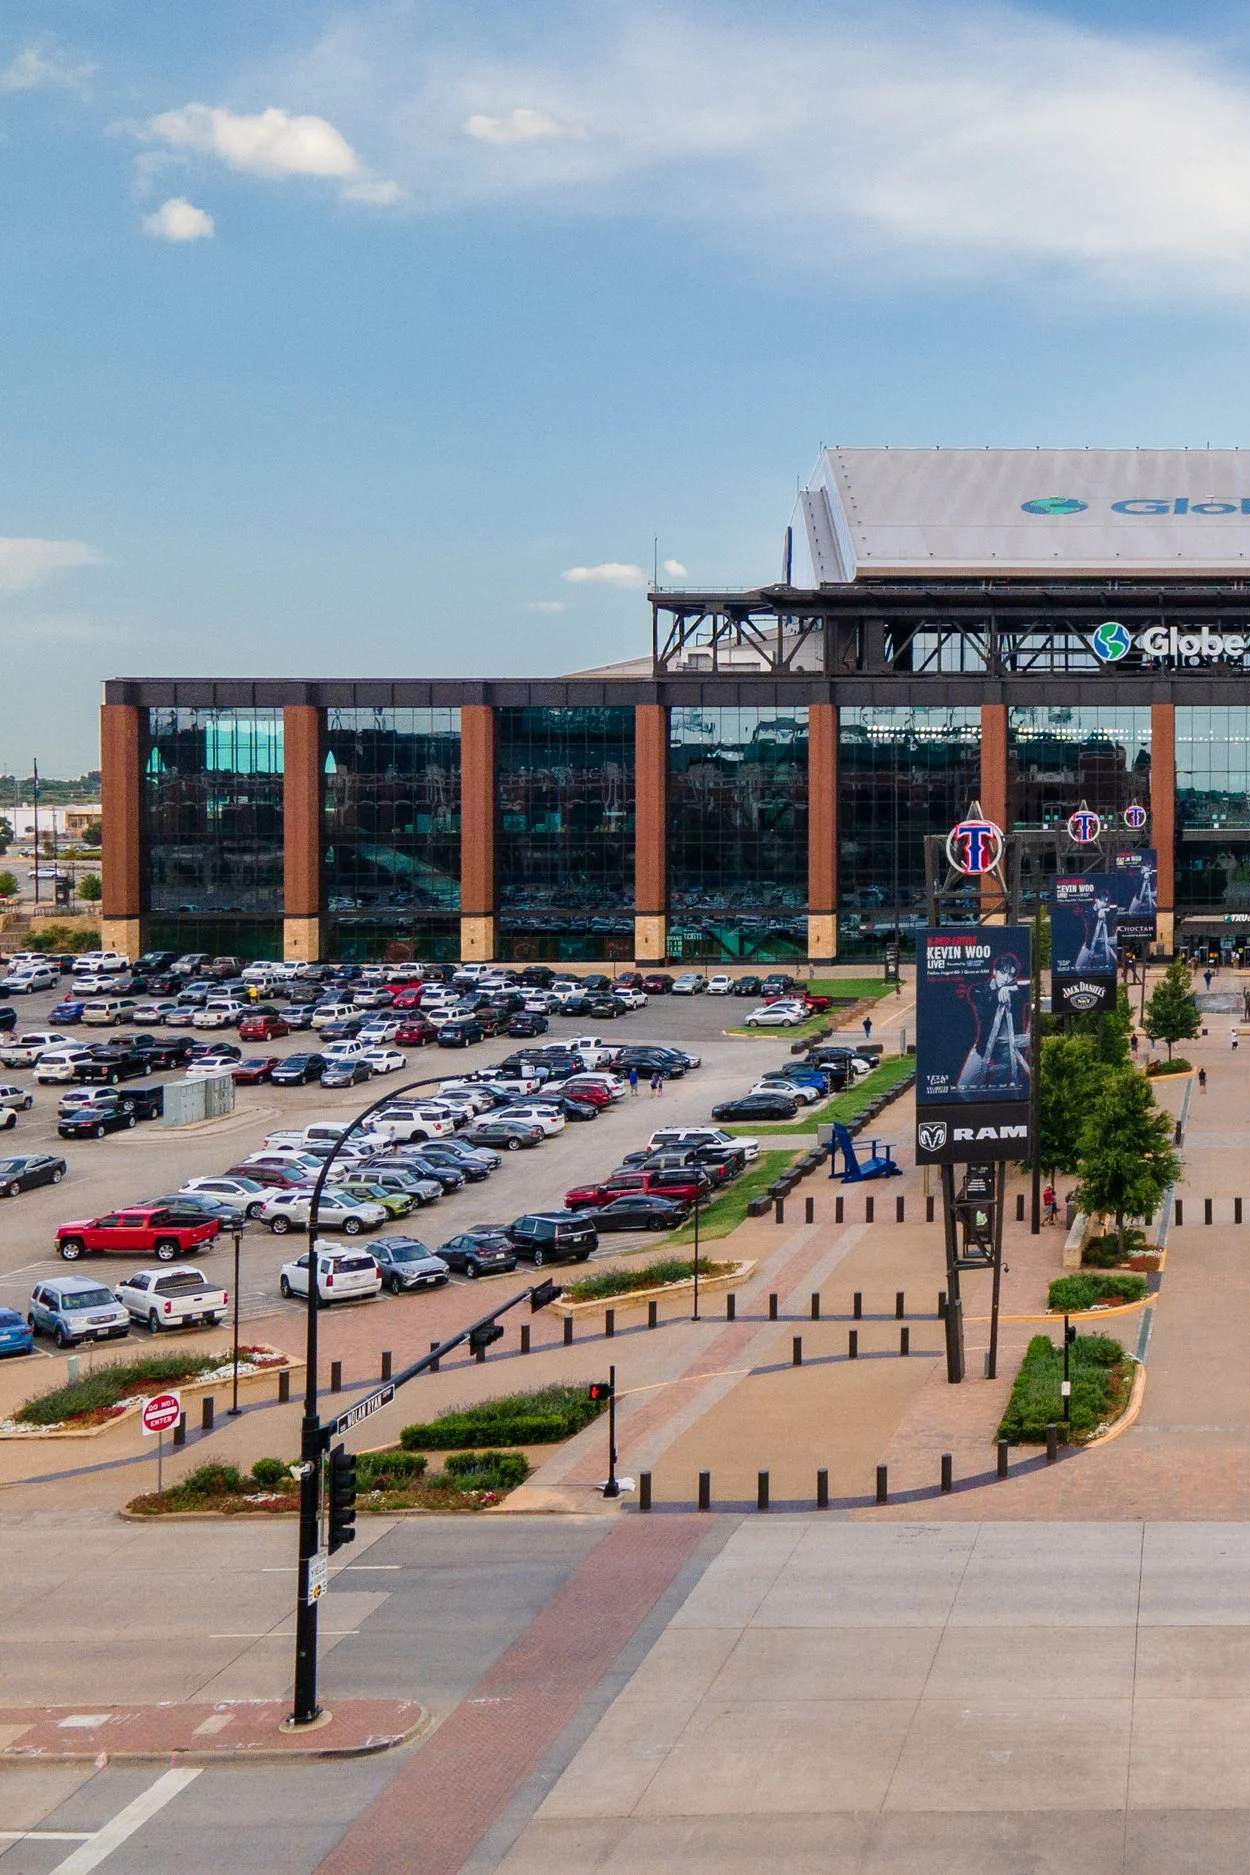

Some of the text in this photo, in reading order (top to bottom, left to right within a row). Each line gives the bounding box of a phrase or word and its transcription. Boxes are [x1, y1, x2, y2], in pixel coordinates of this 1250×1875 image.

[1142, 625, 1246, 656] Globe
[1079, 884, 1094, 892] WOO
[1231, 914, 1248, 922] TXU
[927, 945, 991, 959] KEVIN WOO
[927, 960, 945, 969] LIVE!
[1062, 981, 1107, 999] JACK DANIEL'S
[953, 1125, 1028, 1141] RAM
[148, 1399, 174, 1411] DO NOT
[347, 1394, 382, 1428] NOLAN RYAN
[150, 1415, 173, 1427] ENTER
